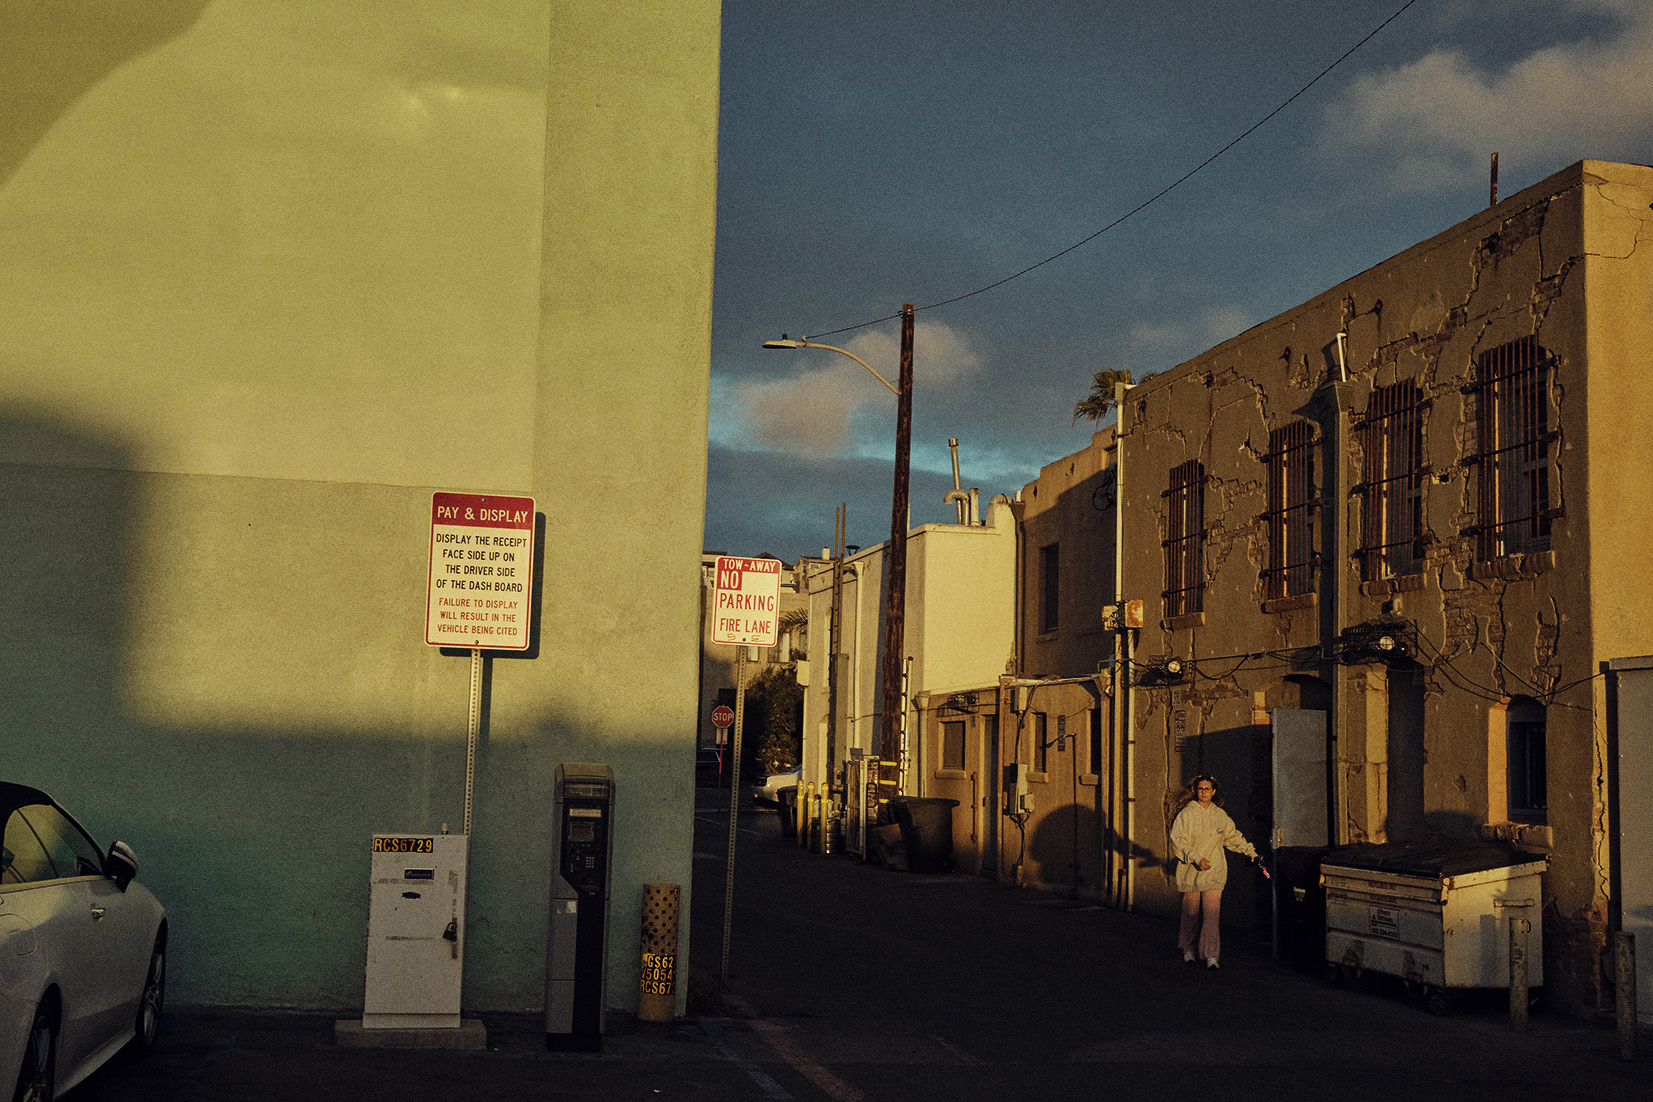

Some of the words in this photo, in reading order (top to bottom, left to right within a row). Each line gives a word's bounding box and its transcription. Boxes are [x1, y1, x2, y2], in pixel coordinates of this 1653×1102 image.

[437, 506, 459, 519] PAY
[464, 508, 475, 520] &
[480, 508, 528, 523] DISPLAY
[436, 534, 471, 544] DISPLAY
[475, 536, 490, 546] THE
[494, 537, 527, 548] RECEIPT
[443, 549, 464, 559] FACE
[467, 550, 486, 560] SIDE
[489, 552, 500, 561] UP
[503, 553, 515, 562] ON
[446, 564, 461, 574] THE
[464, 566, 493, 576] DRIVER
[497, 567, 515, 577] SIDE
[723, 558, 776, 572] TOW-AWAY
[436, 579, 447, 588] OF
[451, 580, 466, 589] THE
[469, 581, 492, 591] DASH
[495, 582, 522, 593] BOARD
[721, 570, 739, 589] NO
[439, 598, 470, 607] FAILURE
[474, 599, 483, 607] TO
[486, 600, 518, 609] DISPLAY
[720, 593, 774, 611] PARKING
[440, 611, 457, 620] WILL
[461, 612, 488, 621] RESULT
[492, 614, 499, 622] IN
[502, 614, 516, 622] THE
[437, 624, 468, 634] VEHICLE
[472, 626, 494, 635] BEING
[497, 627, 518, 636] CITED
[720, 618, 741, 632] FIRE
[745, 619, 771, 634] LANE
[714, 712, 732, 721] STOP
[374, 838, 432, 852] RCS6729
